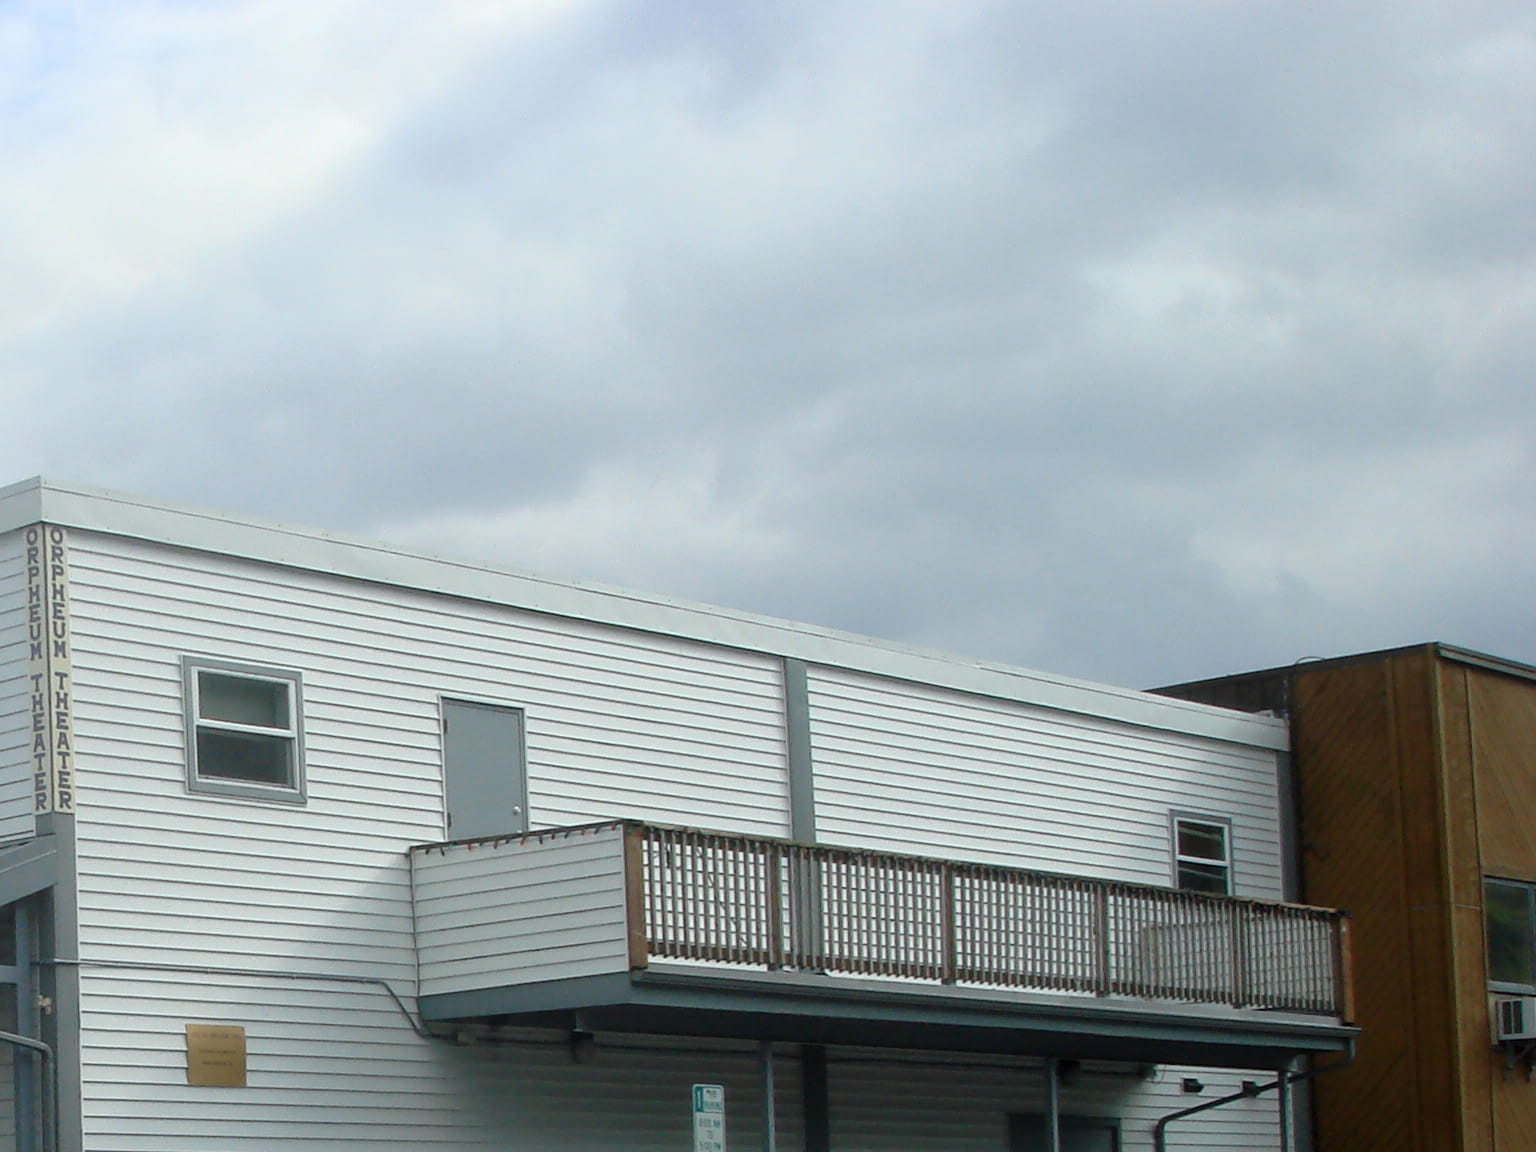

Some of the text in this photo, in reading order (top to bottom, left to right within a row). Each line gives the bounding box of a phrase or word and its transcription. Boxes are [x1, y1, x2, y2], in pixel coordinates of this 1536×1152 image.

[26, 528, 48, 811] ORPHEUM THEATER
[50, 527, 73, 810] ORPHEUM THEATER
